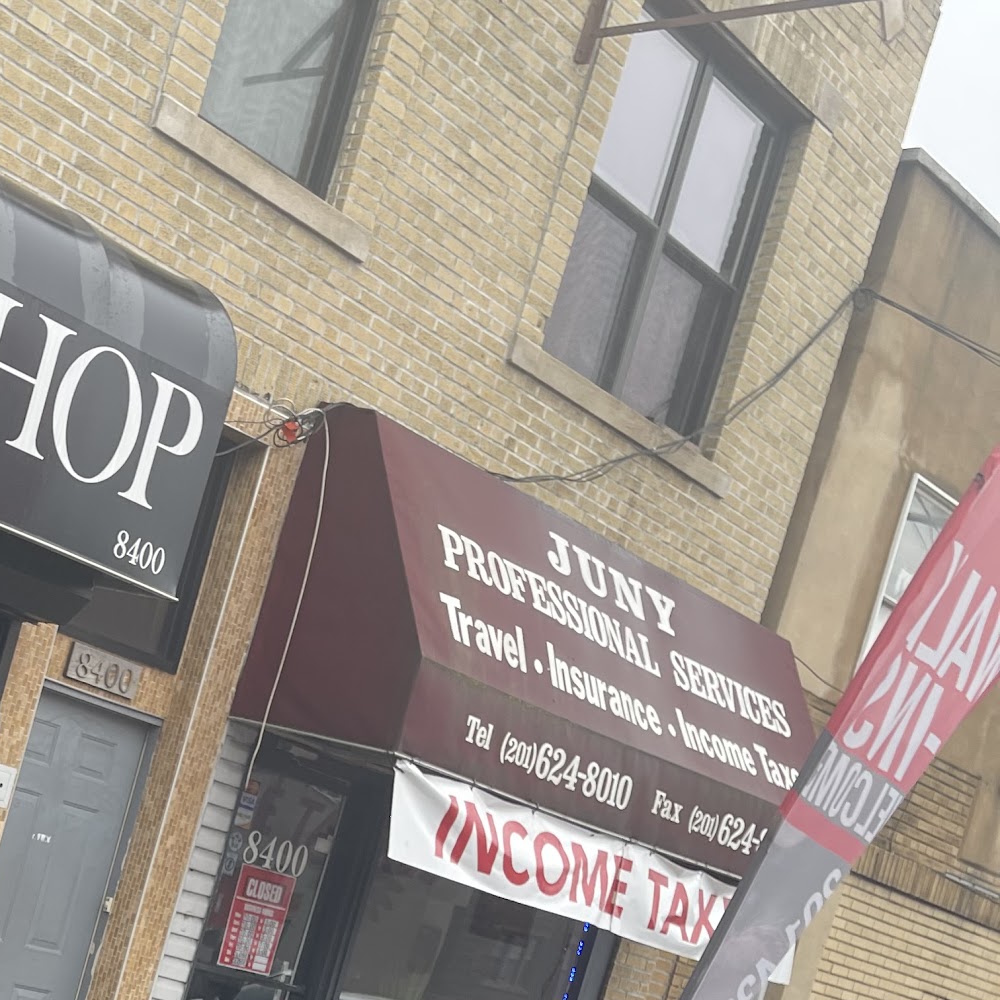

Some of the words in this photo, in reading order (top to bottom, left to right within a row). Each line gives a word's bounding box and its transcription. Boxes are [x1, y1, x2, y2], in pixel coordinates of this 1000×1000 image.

[112, 529, 166, 576] 8400
[548, 531, 677, 637] JUNY
[76, 653, 133, 694] 8400
[437, 524, 662, 680] PROFESSIONAL
[669, 650, 792, 740] SERVICES
[439, 591, 527, 675] Travel
[546, 641, 663, 737] Insurance
[675, 707, 758, 777] Income
[465, 714, 495, 752] Tel
[650, 789, 684, 824] Fax
[242, 830, 309, 878] 8400
[246, 878, 284, 904] CLOSED
[434, 793, 634, 919] INCOME
